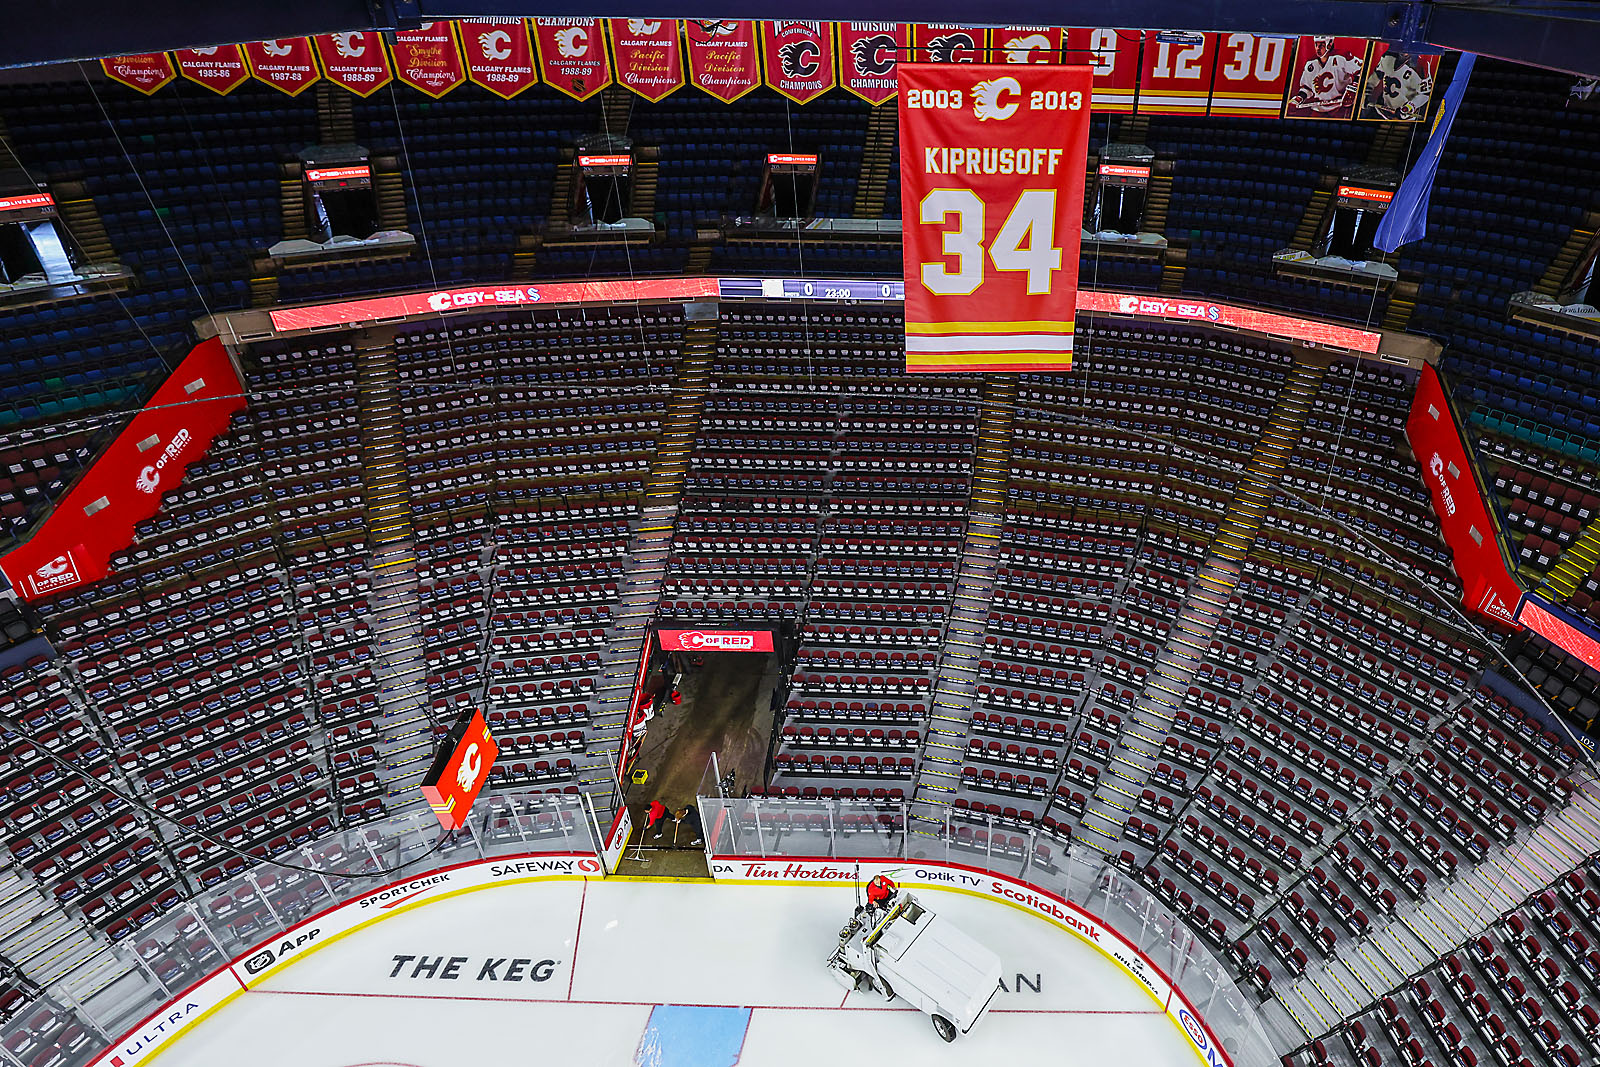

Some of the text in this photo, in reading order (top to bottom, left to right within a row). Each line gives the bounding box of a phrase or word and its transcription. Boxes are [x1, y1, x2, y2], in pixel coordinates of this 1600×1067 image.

[537, 17, 595, 27] CHAMPIONS
[406, 44, 442, 58] Smythe
[630, 49, 665, 62] Pacific
[706, 50, 741, 63] Pacific
[1088, 28, 1118, 76] 9
[1152, 32, 1204, 79] 12
[1224, 33, 1286, 81] 30
[407, 58, 447, 67] Division
[629, 62, 670, 72] Division
[704, 63, 745, 73] Division
[114, 64, 166, 79] Champions
[197, 69, 231, 78] 1985-86
[270, 72, 302, 81] 1987-88
[342, 74, 375, 82] 1988-89
[406, 68, 456, 82] Champions
[486, 74, 519, 82] 1988-89
[624, 72, 677, 87] Champions
[699, 73, 751, 88] Champions
[779, 79, 823, 91] CHAMPIONS
[907, 89, 963, 109] 2003
[1030, 90, 1082, 110] 2013
[924, 147, 1063, 175] KIPRUSOFF
[919, 187, 1063, 296] 34
[804, 283, 813, 296] 0
[825, 288, 851, 298] 23:00
[881, 285, 890, 297] 0
[156, 453, 168, 469] OF
[165, 428, 189, 458] RED
[1443, 486, 1456, 515] RED
[49, 572, 74, 584] RED
[722, 637, 750, 645] RED
[490, 859, 574, 877] SAFEWAY
[713, 865, 734, 873] DA
[741, 863, 858, 880] Tim Hortons
[915, 869, 981, 886] Optik TV
[359, 873, 450, 909] SPORTCHEK
[991, 881, 1101, 943] Scotiabank
[277, 928, 321, 957] APP
[389, 954, 556, 983] THE KEG
[126, 1003, 199, 1056] ULTRA
